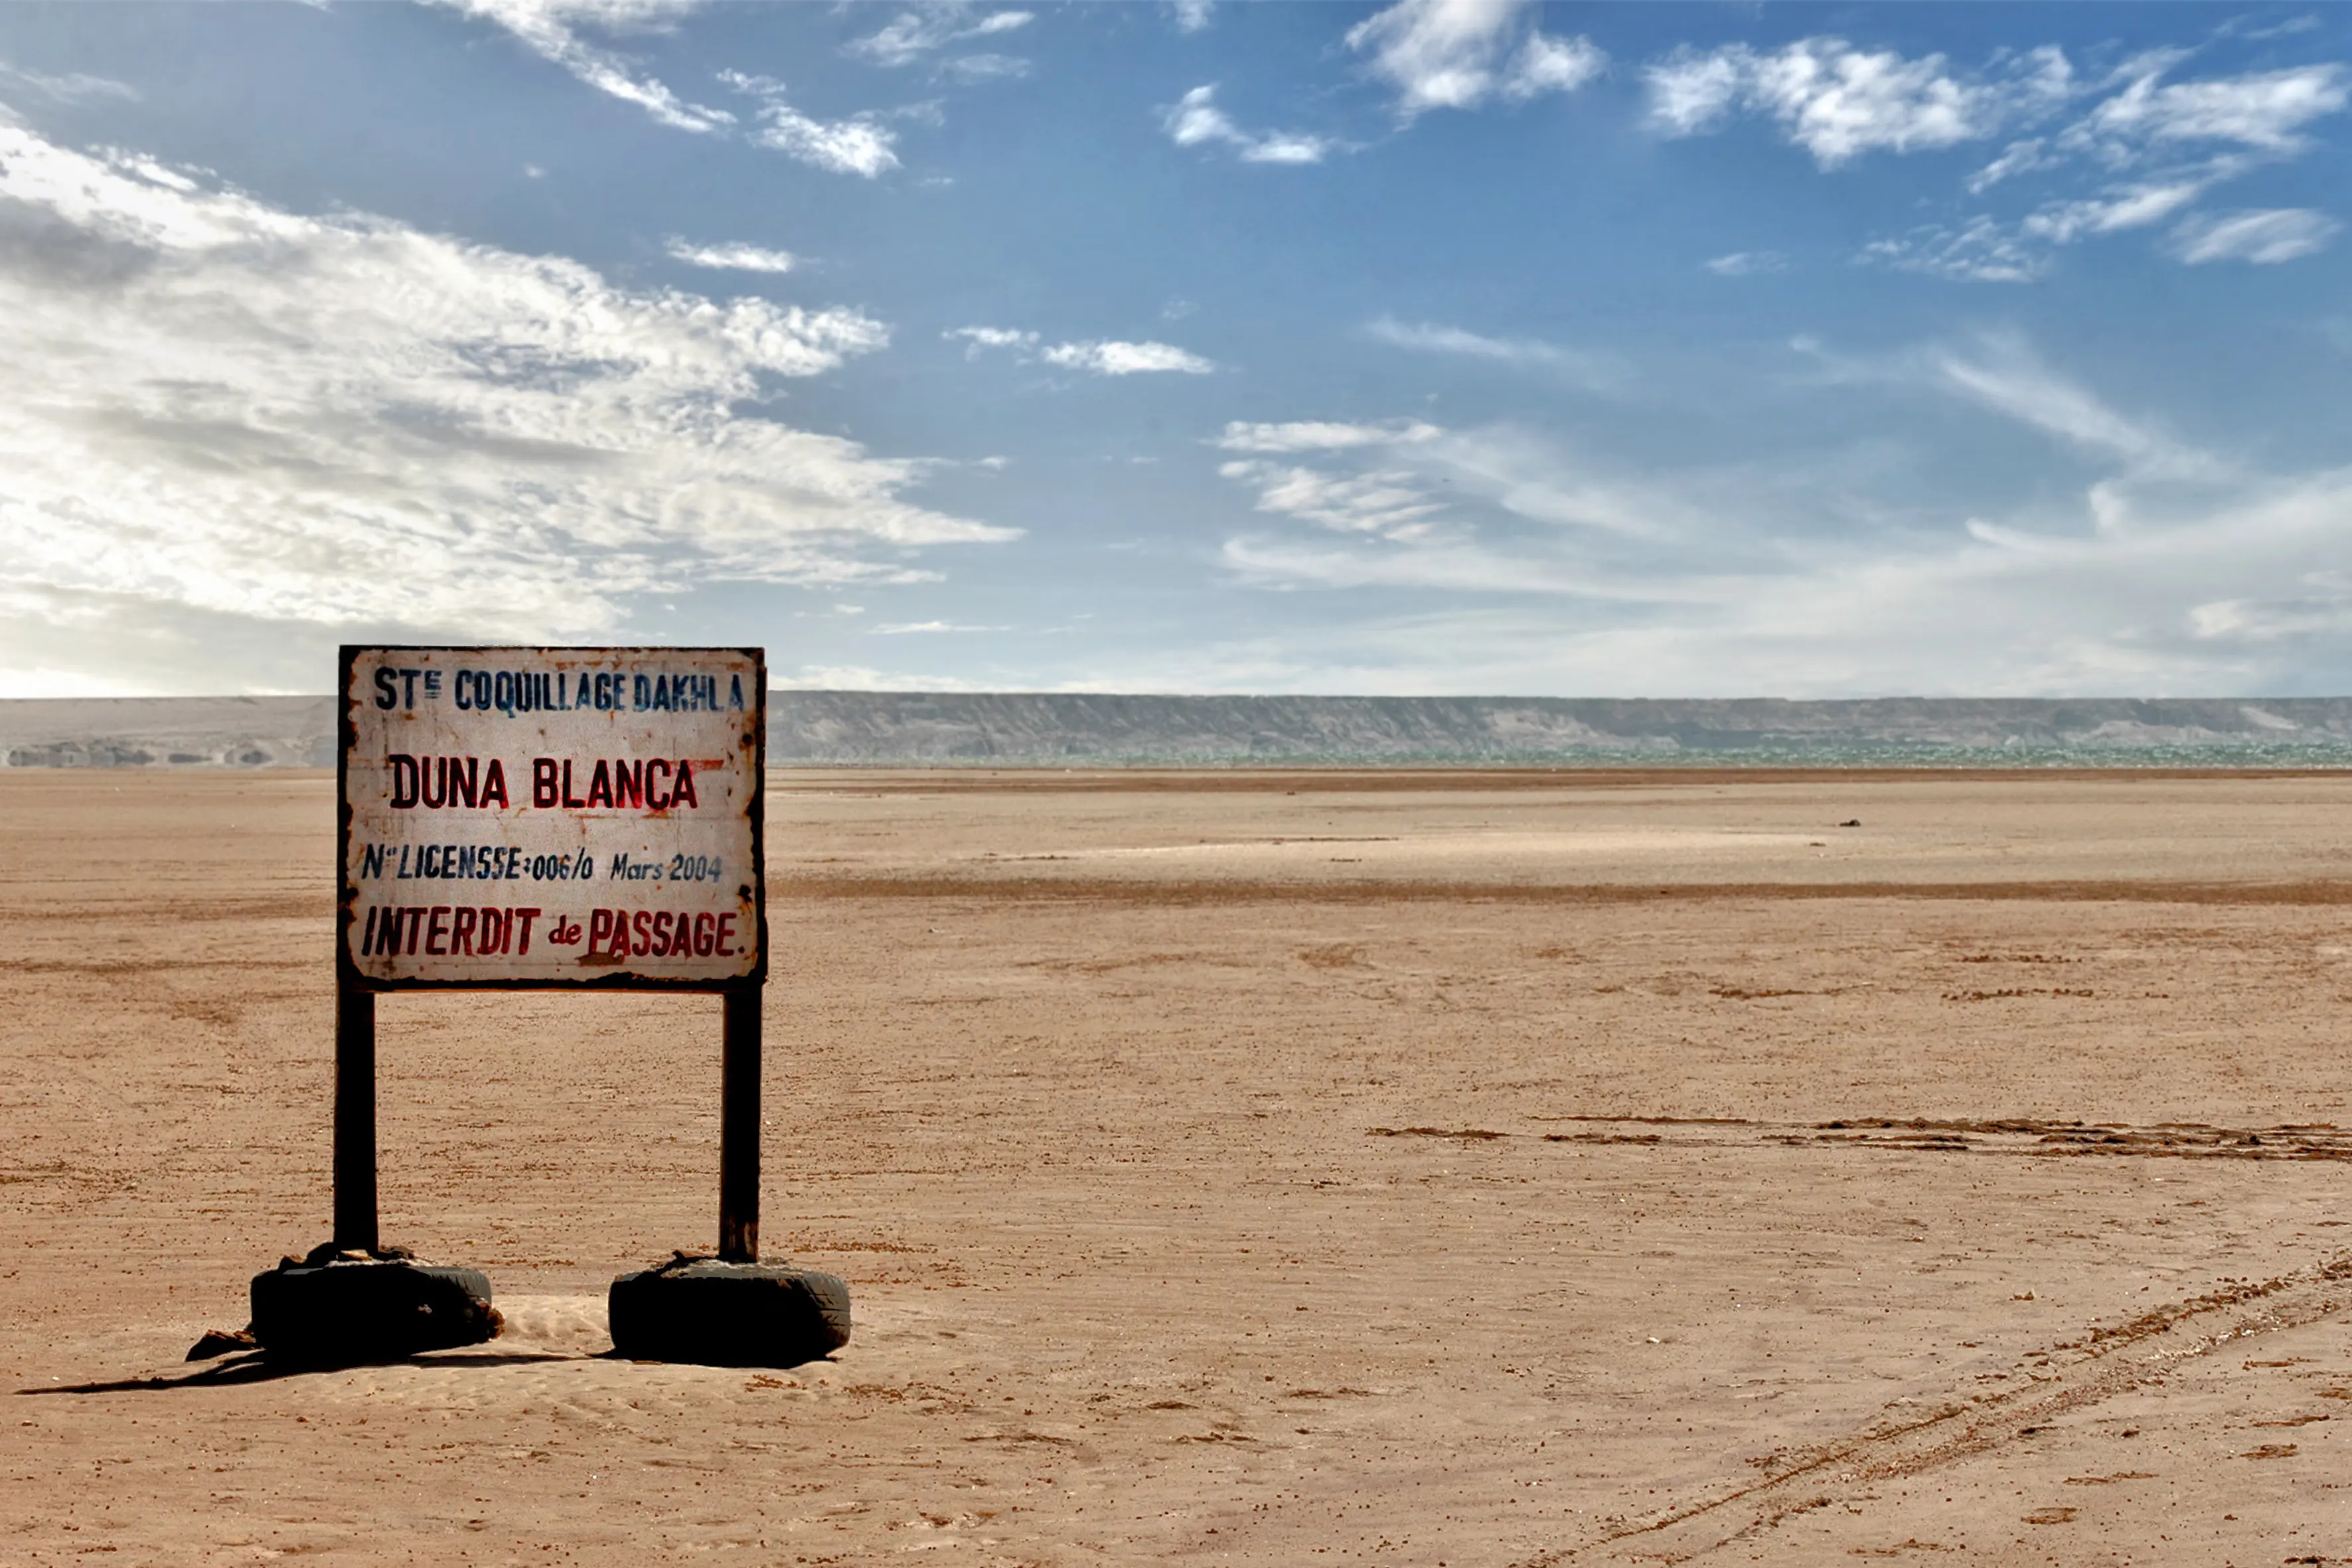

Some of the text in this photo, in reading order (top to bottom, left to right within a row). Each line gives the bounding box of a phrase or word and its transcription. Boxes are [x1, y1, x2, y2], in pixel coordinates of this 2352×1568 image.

[455, 669, 626, 718] COQUILLAGE
[632, 673, 744, 713] DAKHLA
[389, 754, 698, 811] DUNA BLANCA
[610, 852, 663, 880] Mars
[669, 853, 722, 882] 2004
[361, 905, 746, 957] INTERDIT de PASSAGE.
